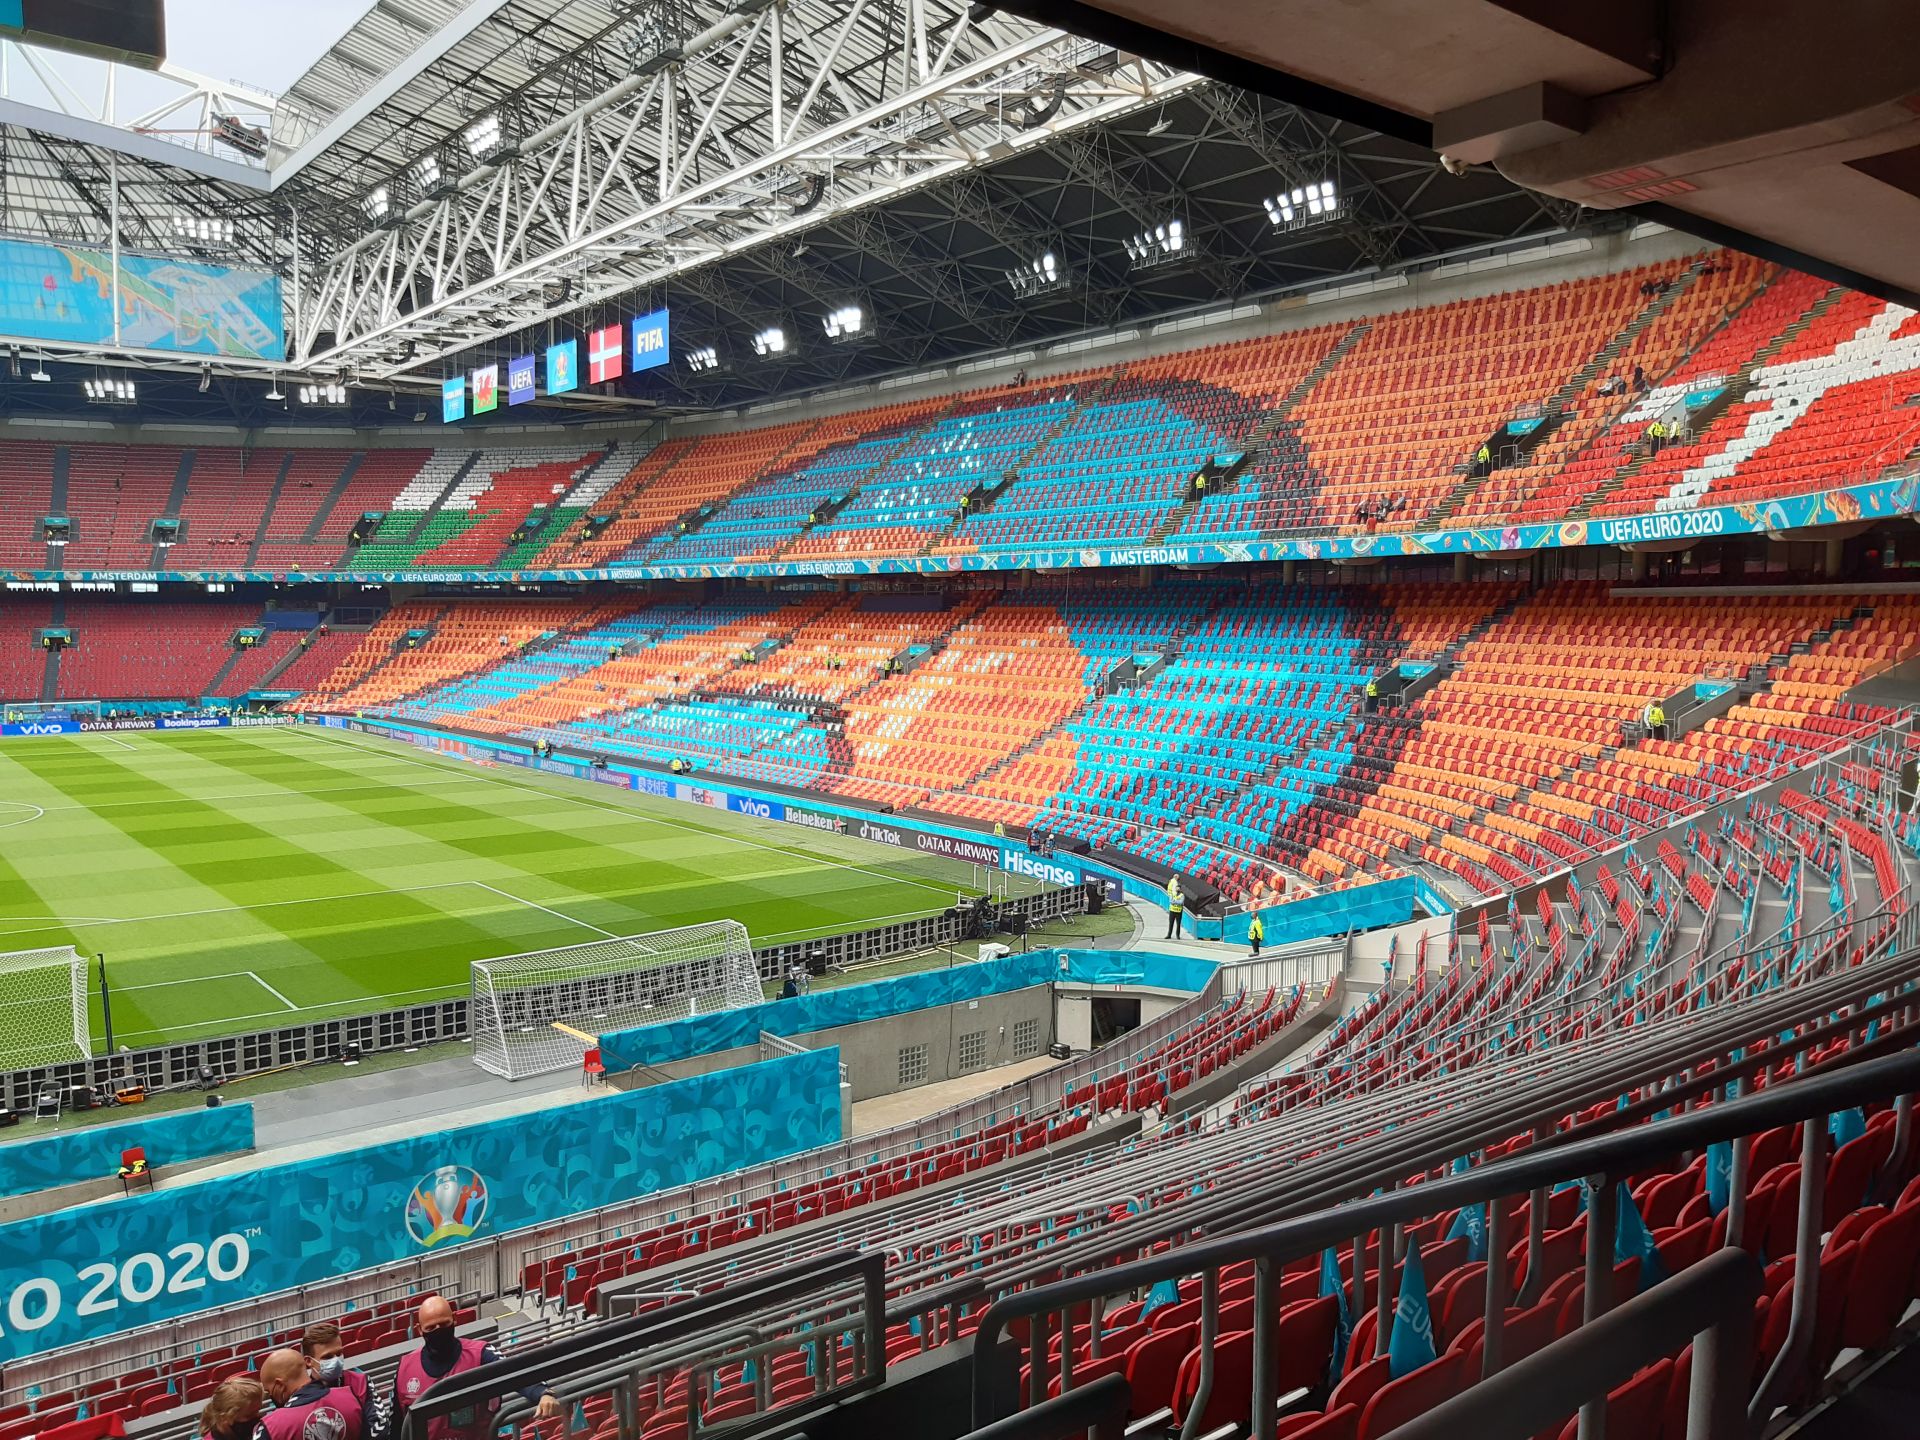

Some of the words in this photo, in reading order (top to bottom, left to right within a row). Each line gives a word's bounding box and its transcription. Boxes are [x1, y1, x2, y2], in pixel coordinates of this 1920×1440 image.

[637, 330, 664, 354] FIFA
[511, 371, 532, 390] UEFA
[1602, 520, 1641, 542] UEFA
[1642, 515, 1682, 539] EURO
[1683, 510, 1724, 535] 2020
[1110, 549, 1188, 565] AMSTERDAM
[92, 572, 157, 581] AMSTERDAM
[611, 570, 643, 579] AMSTERDAM
[796, 565, 815, 575] UEFA
[816, 564, 836, 575] EURO
[836, 563, 855, 574] 2020
[401, 574, 424, 582] UEFA
[424, 574, 445, 582] EURO
[20, 723, 62, 734] vivo
[80, 722, 113, 732] QATAR
[115, 720, 156, 730] AIRWAYS
[165, 718, 220, 728] Booking.com
[232, 715, 285, 727] Heineken
[540, 759, 575, 776] AMSTERDAM
[597, 770, 630, 785] Volkswagen
[691, 788, 714, 805] FedEx
[739, 798, 770, 817] vivo
[785, 807, 833, 830] Heineken
[870, 826, 901, 845] TikTok
[917, 834, 951, 853] QATAR
[954, 842, 999, 863] AIRWAYS
[1004, 851, 1075, 886] Hisense
[0, 1277, 62, 1337] O
[77, 1233, 250, 1317] 2020
